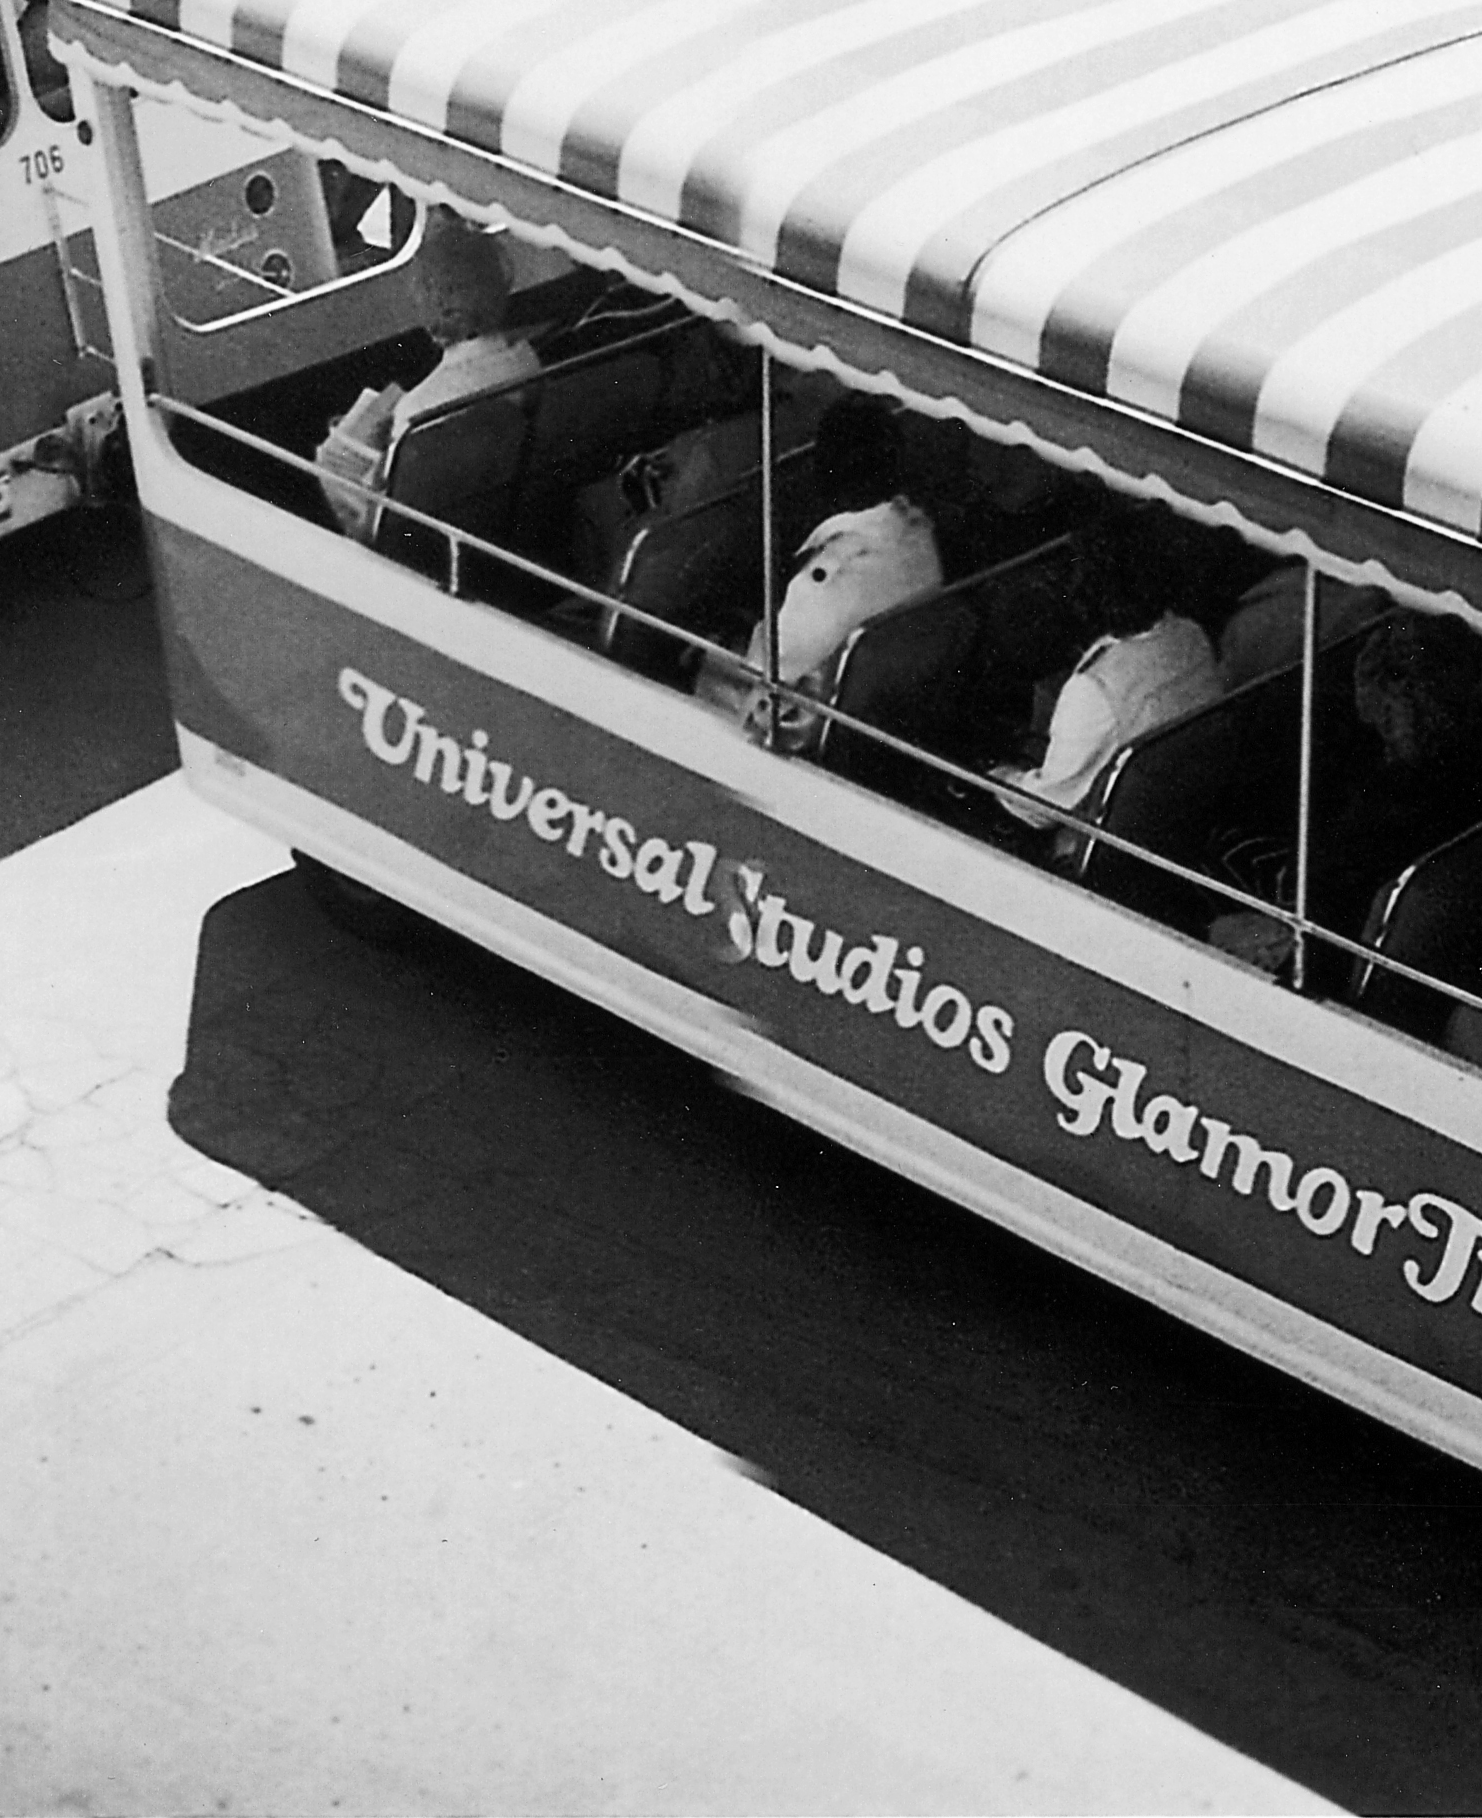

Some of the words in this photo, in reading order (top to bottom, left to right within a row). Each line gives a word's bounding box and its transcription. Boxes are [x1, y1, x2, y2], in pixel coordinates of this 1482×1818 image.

[19, 143, 65, 186] 706
[337, 666, 717, 918] Universal
[716, 858, 1015, 1075] Studios
